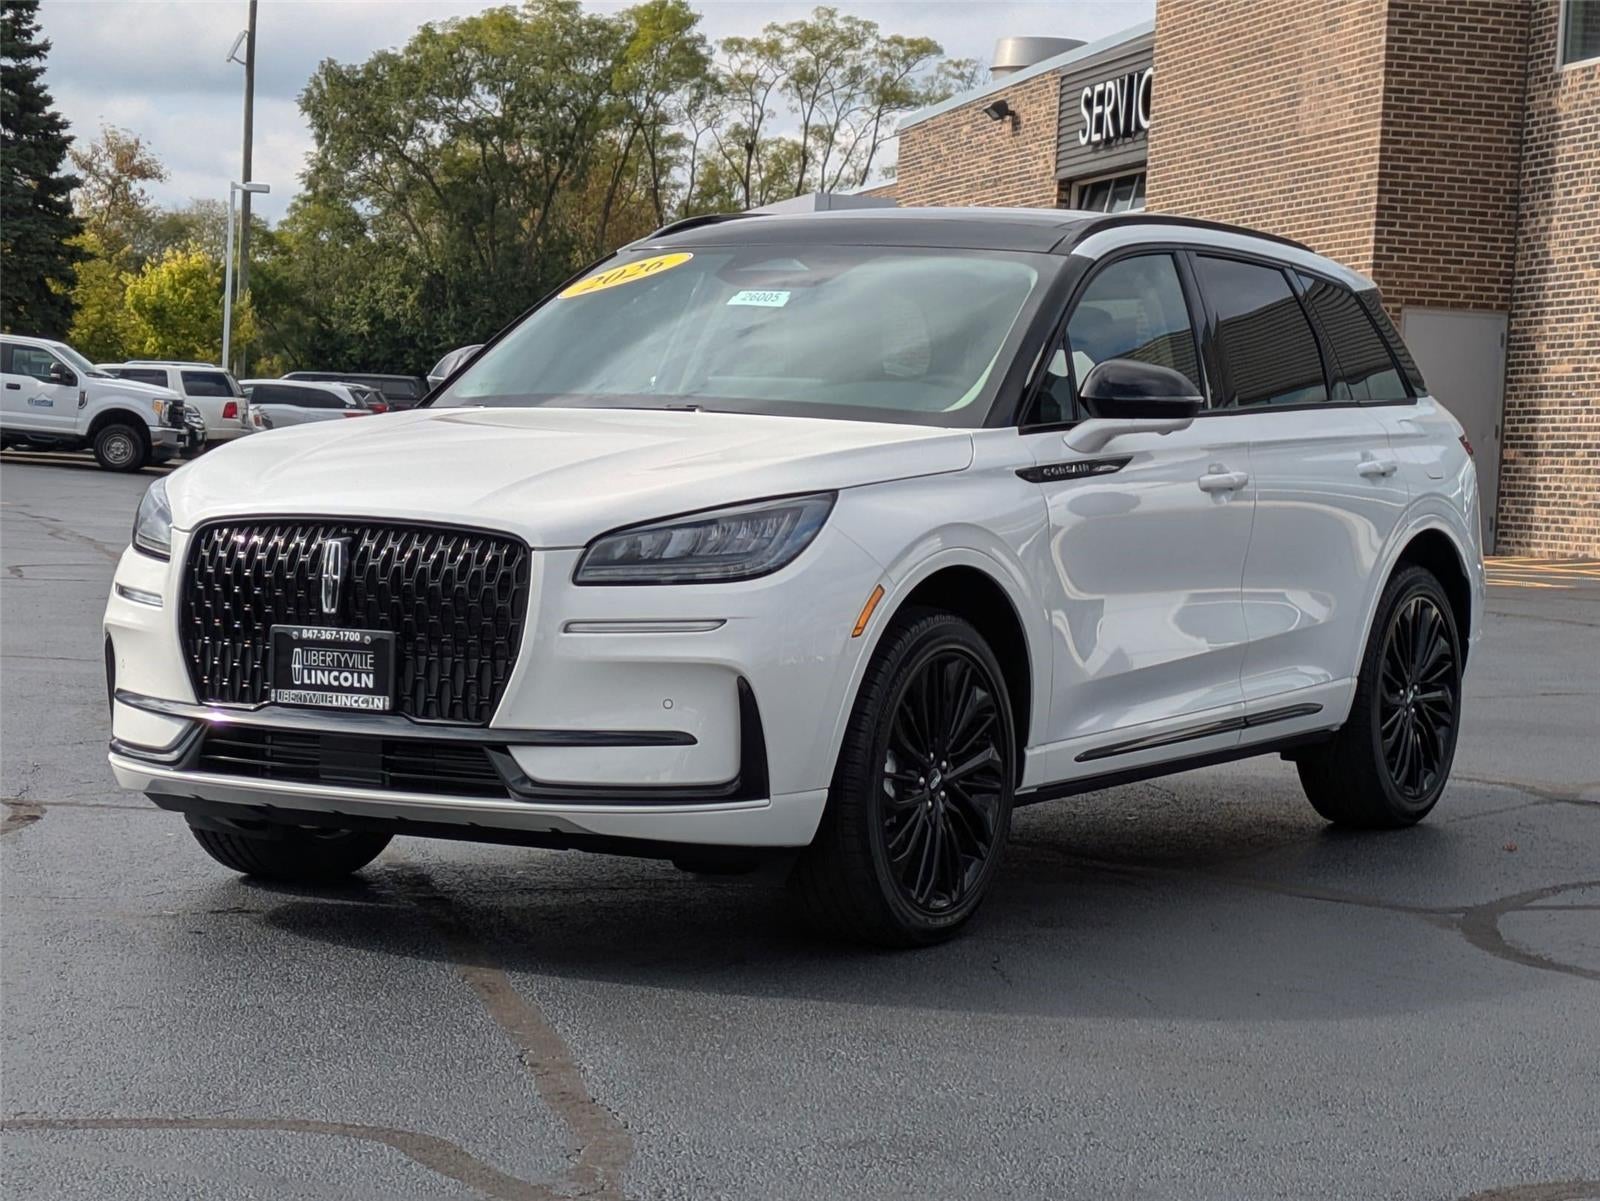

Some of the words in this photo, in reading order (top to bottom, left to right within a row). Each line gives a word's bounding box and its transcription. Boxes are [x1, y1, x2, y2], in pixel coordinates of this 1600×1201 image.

[740, 292, 783, 302] 26005
[1043, 463, 1090, 476] CORSAIR
[302, 629, 361, 642] 847-367-1700
[303, 650, 375, 670] LIBERTYVILLE
[303, 670, 374, 689] LINCOLN
